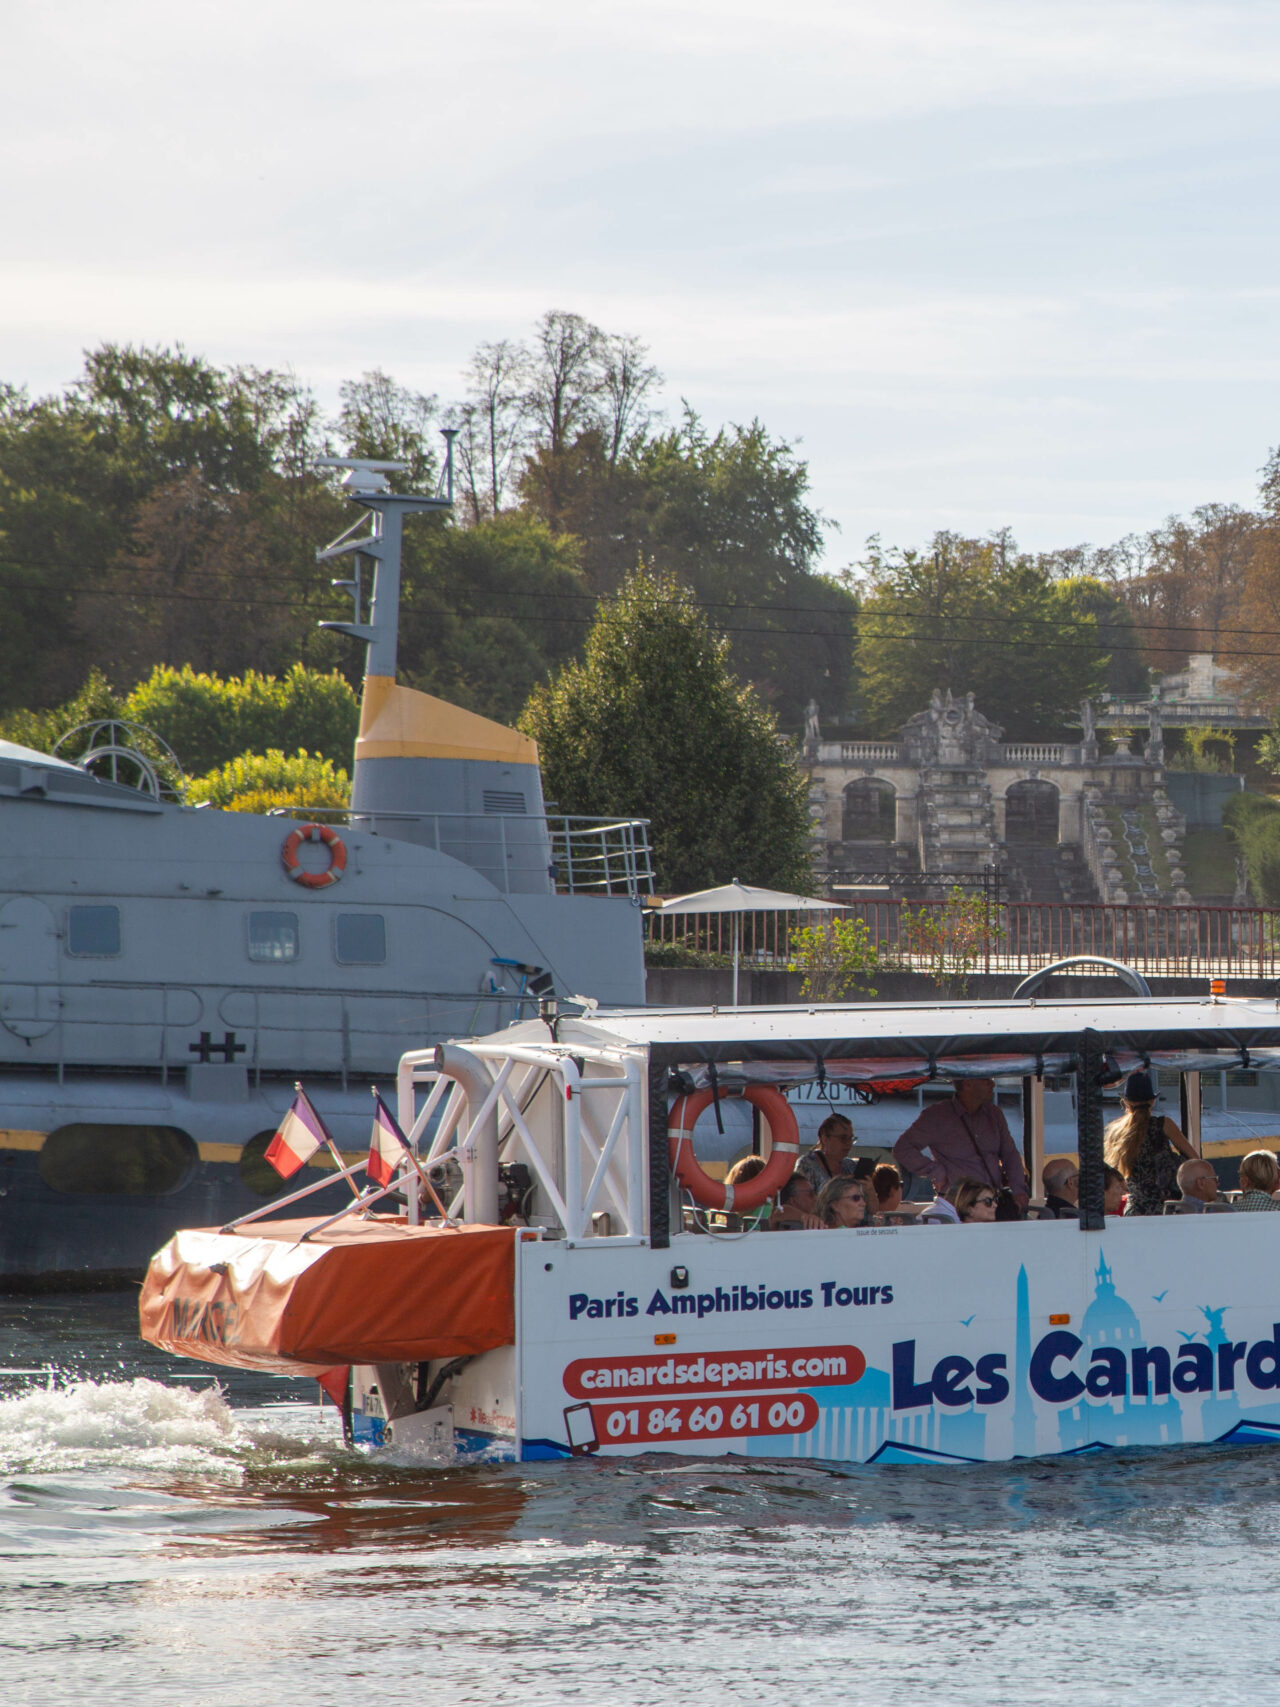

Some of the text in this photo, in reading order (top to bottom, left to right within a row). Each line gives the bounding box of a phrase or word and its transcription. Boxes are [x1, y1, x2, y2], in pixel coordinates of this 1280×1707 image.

[569, 1281, 894, 1320] Paris Amphibious Tours
[580, 1354, 847, 1390] canardsdeparis.com
[892, 1339, 1010, 1411] Les
[606, 1401, 805, 1437] 01 84 60 61 00
